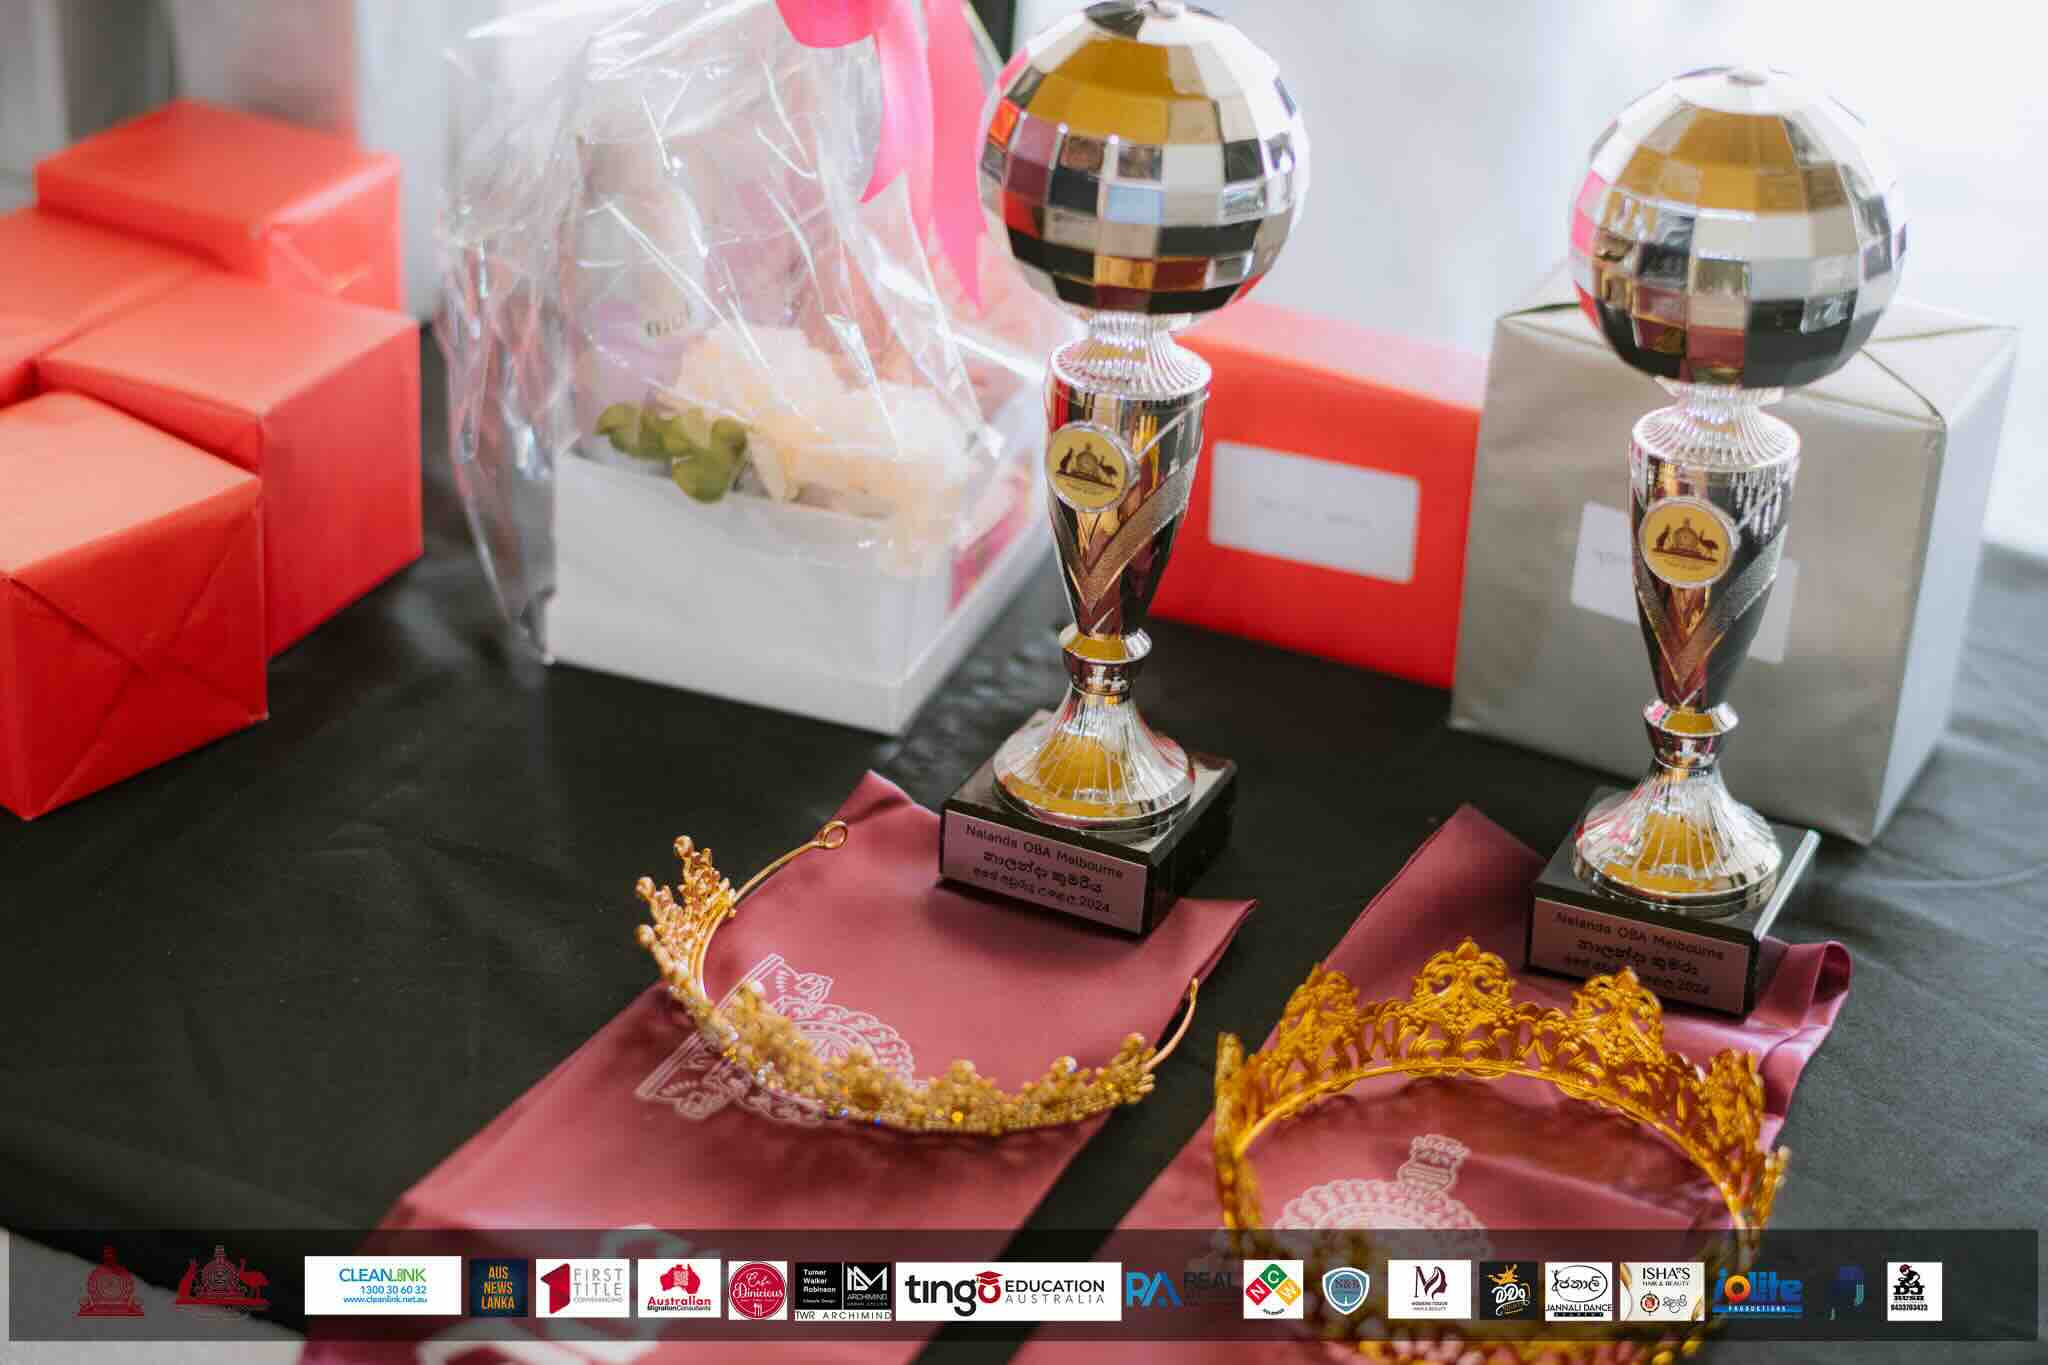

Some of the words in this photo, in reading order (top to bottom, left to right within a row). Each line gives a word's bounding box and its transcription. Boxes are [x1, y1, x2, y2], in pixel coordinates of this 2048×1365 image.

[966, 823, 1018, 848] Nalanda
[1023, 842, 1051, 858] OBA
[1056, 849, 1125, 879] Melbourne
[1079, 895, 1111, 913] 2024
[1555, 911, 1612, 935] Nalanda
[1616, 924, 1648, 943] OBA
[1652, 934, 1724, 960] Melbourne
